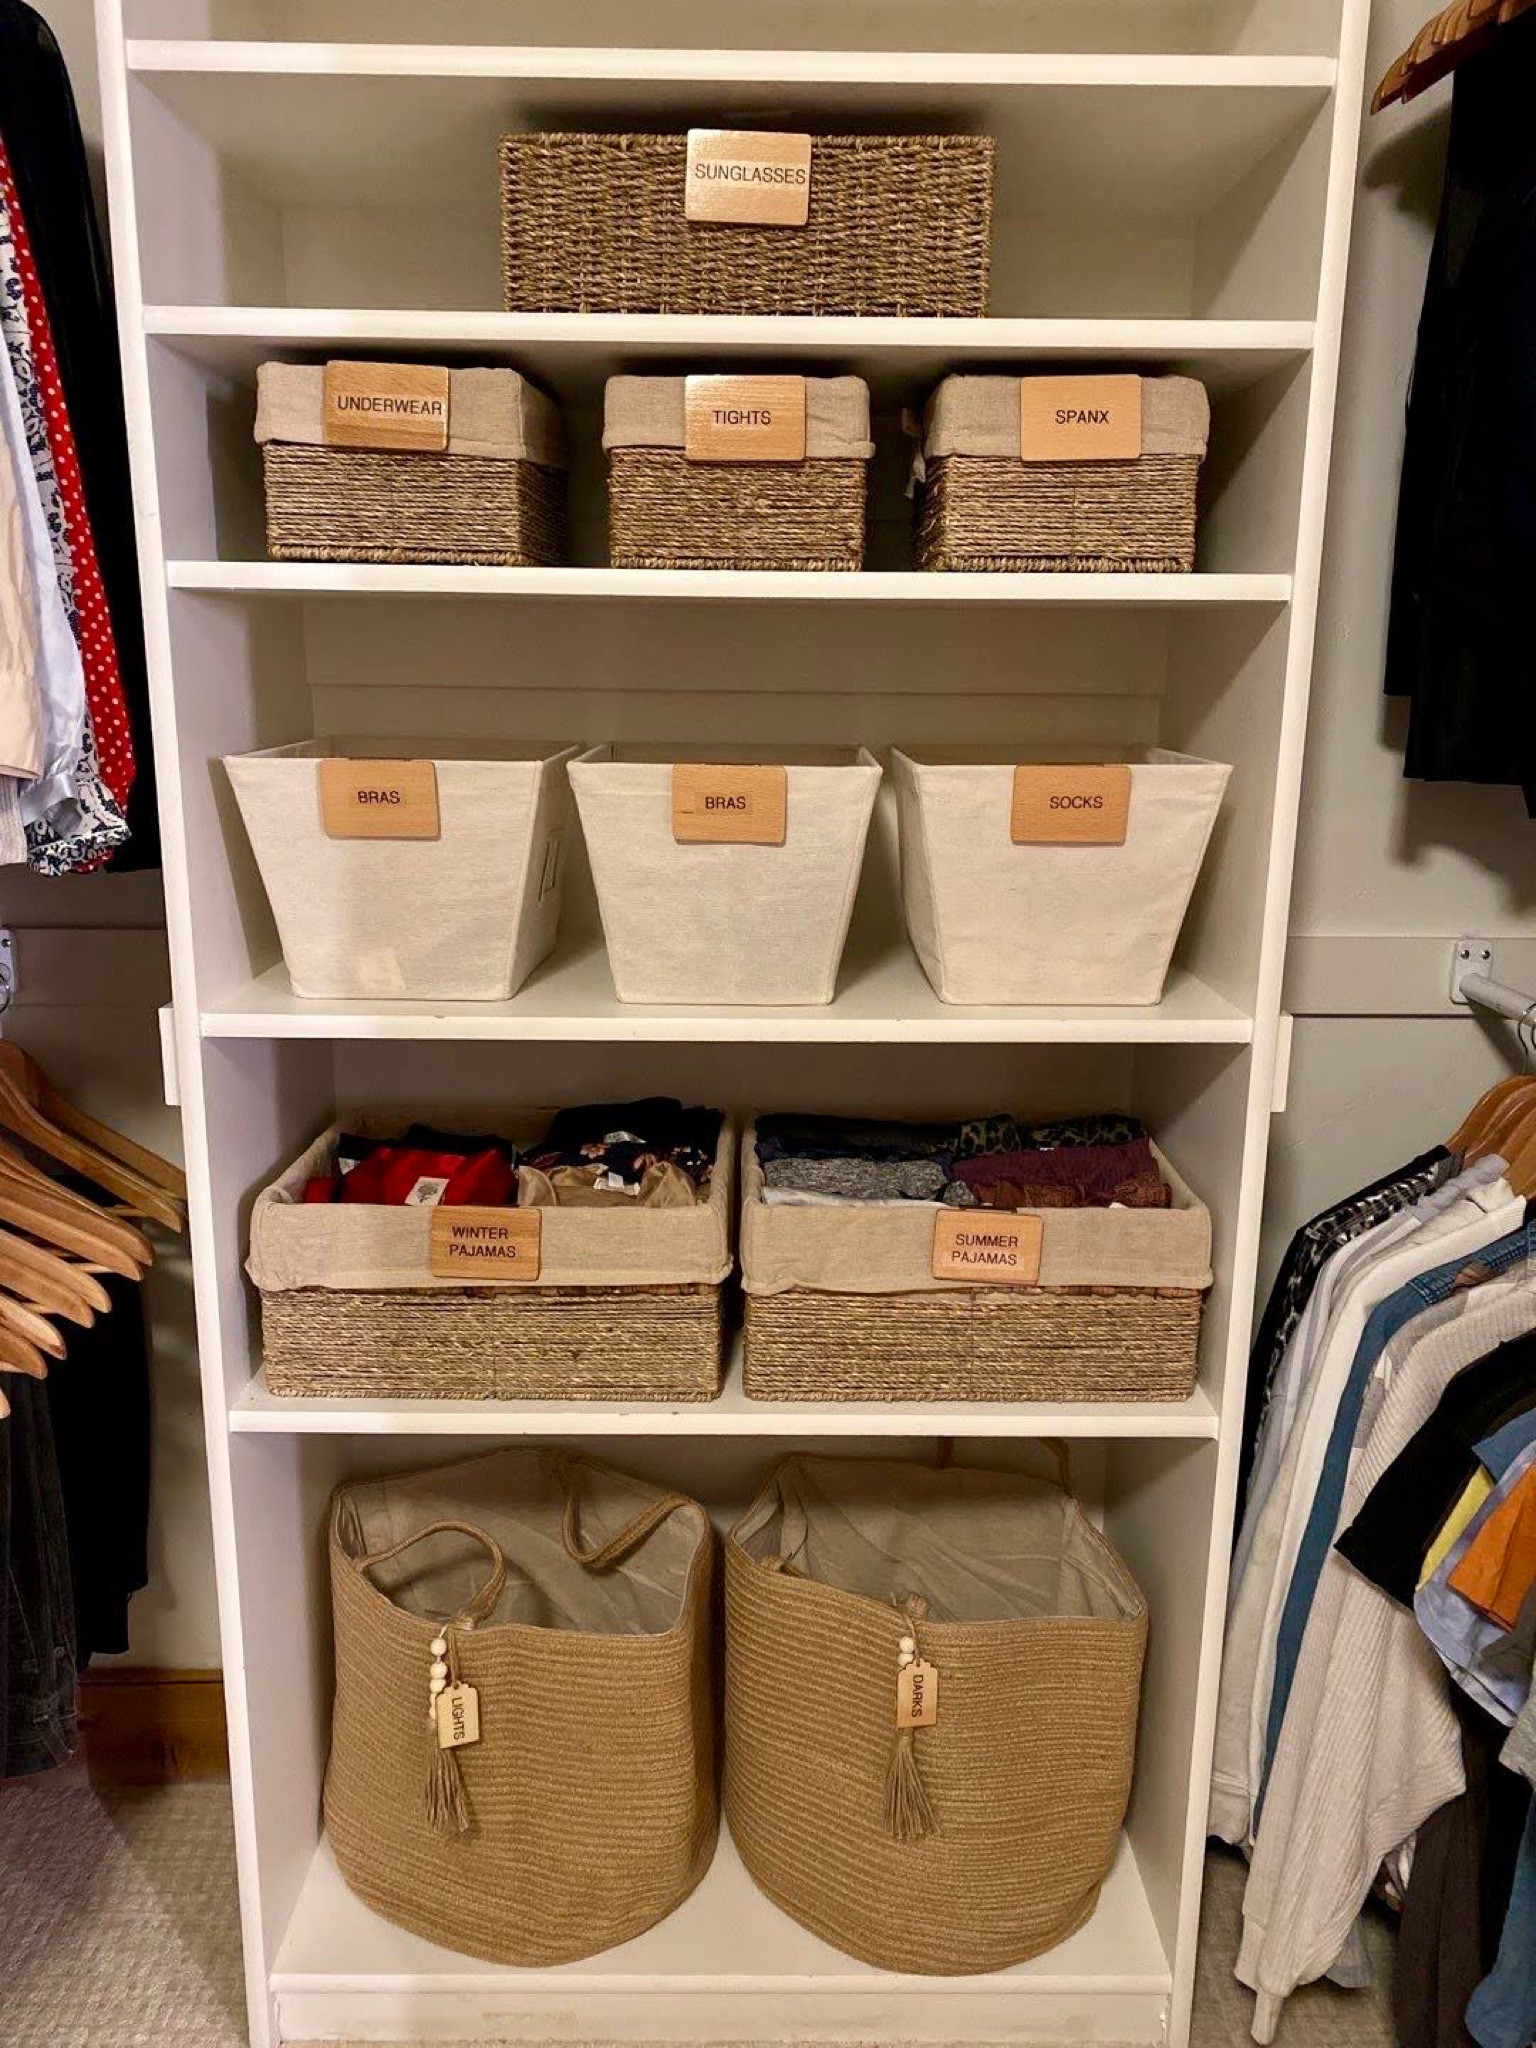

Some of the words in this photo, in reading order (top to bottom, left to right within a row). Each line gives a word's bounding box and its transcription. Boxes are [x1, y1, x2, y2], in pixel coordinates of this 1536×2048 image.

[695, 164, 806, 185] SUNGLASSES
[338, 396, 442, 415] UNDERWEAR
[713, 410, 772, 425] TIGHTS
[1055, 410, 1109, 425] SPANX
[358, 790, 400, 804] BRAS
[705, 796, 746, 809] BRAS
[1049, 795, 1103, 810] SOCKS
[451, 1226, 508, 1240] WINTER
[955, 1233, 1018, 1248] SUMMER
[449, 1244, 516, 1259] PAJAMAS
[951, 1251, 1017, 1266] PAJAMAS
[912, 1674, 924, 1717] DARKS
[453, 1697, 466, 1741] LIGHTS
